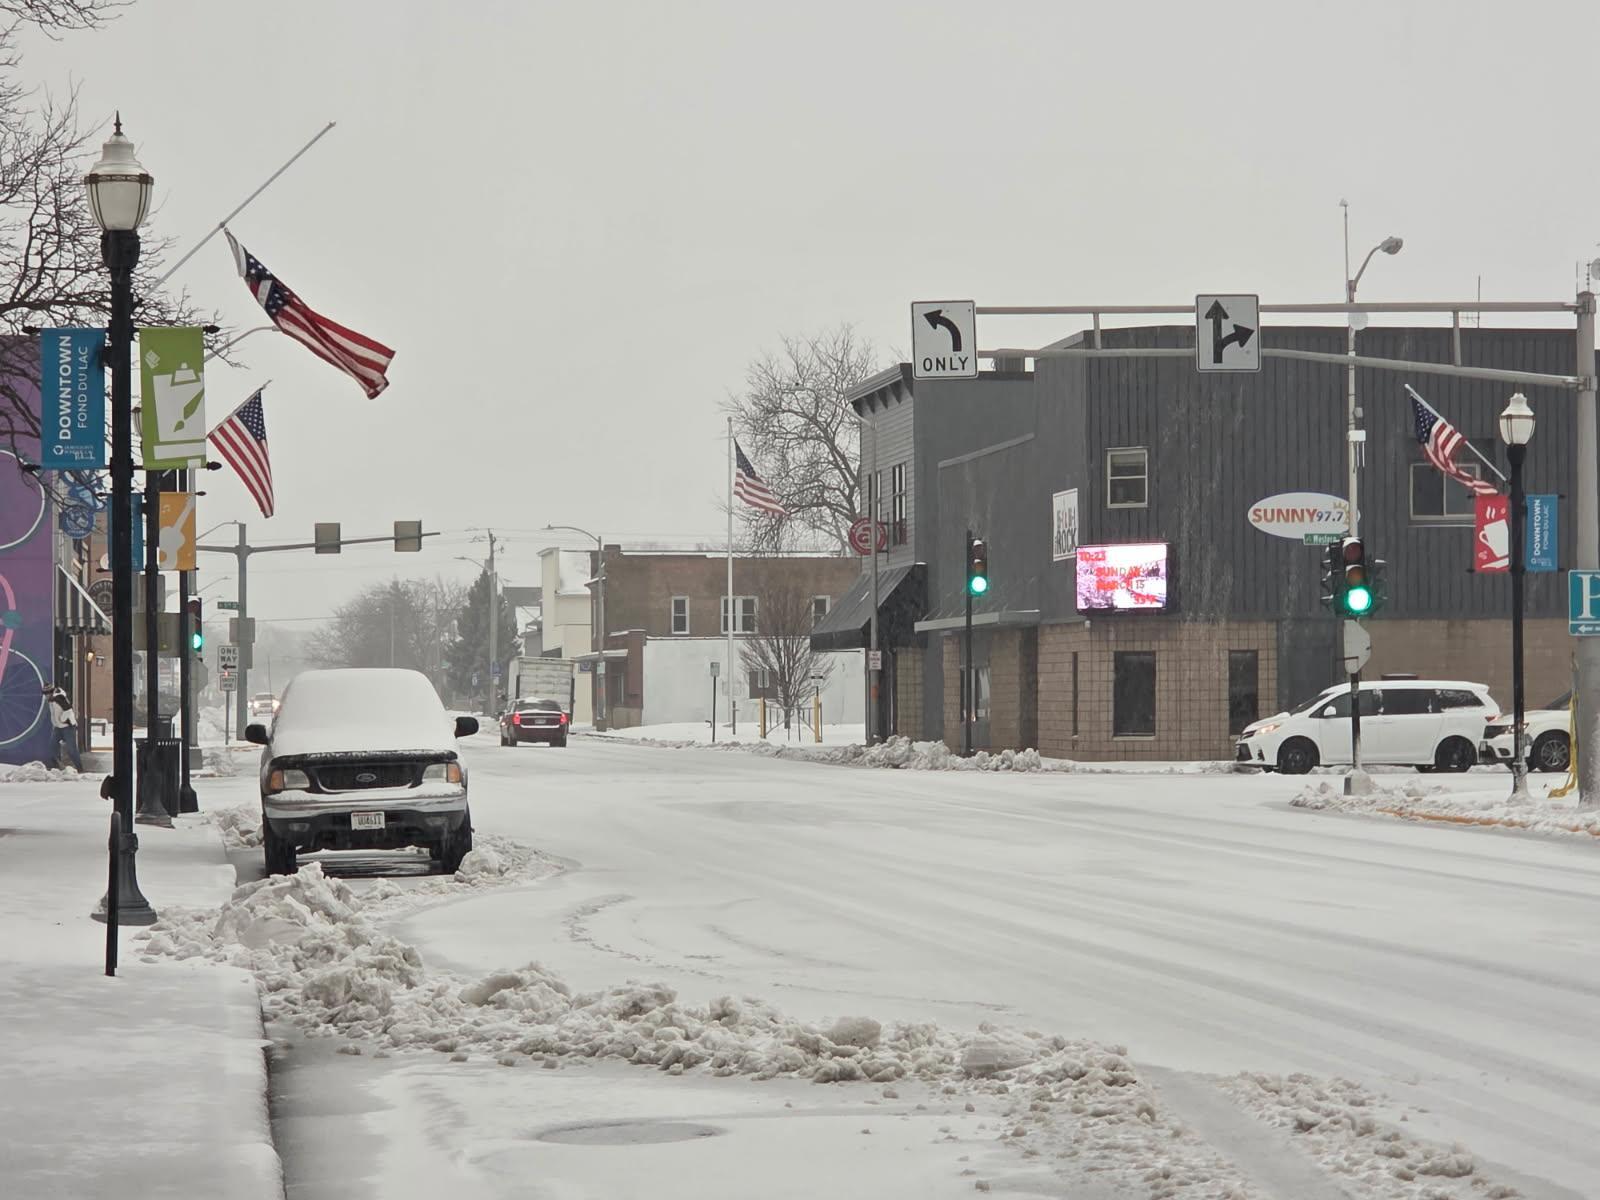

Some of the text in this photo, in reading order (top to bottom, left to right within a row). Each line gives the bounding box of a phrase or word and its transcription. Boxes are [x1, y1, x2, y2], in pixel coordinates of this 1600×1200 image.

[923, 356, 969, 372] ONLY
[59, 335, 72, 440] DOWNTOWN
[78, 346, 88, 429] FOND DU LAC
[1252, 508, 1344, 523] SUNNY 97.7
[1533, 499, 1541, 556] DOWNTOWN
[1096, 566, 1141, 577] SUNDAY
[220, 647, 238, 655] ONE
